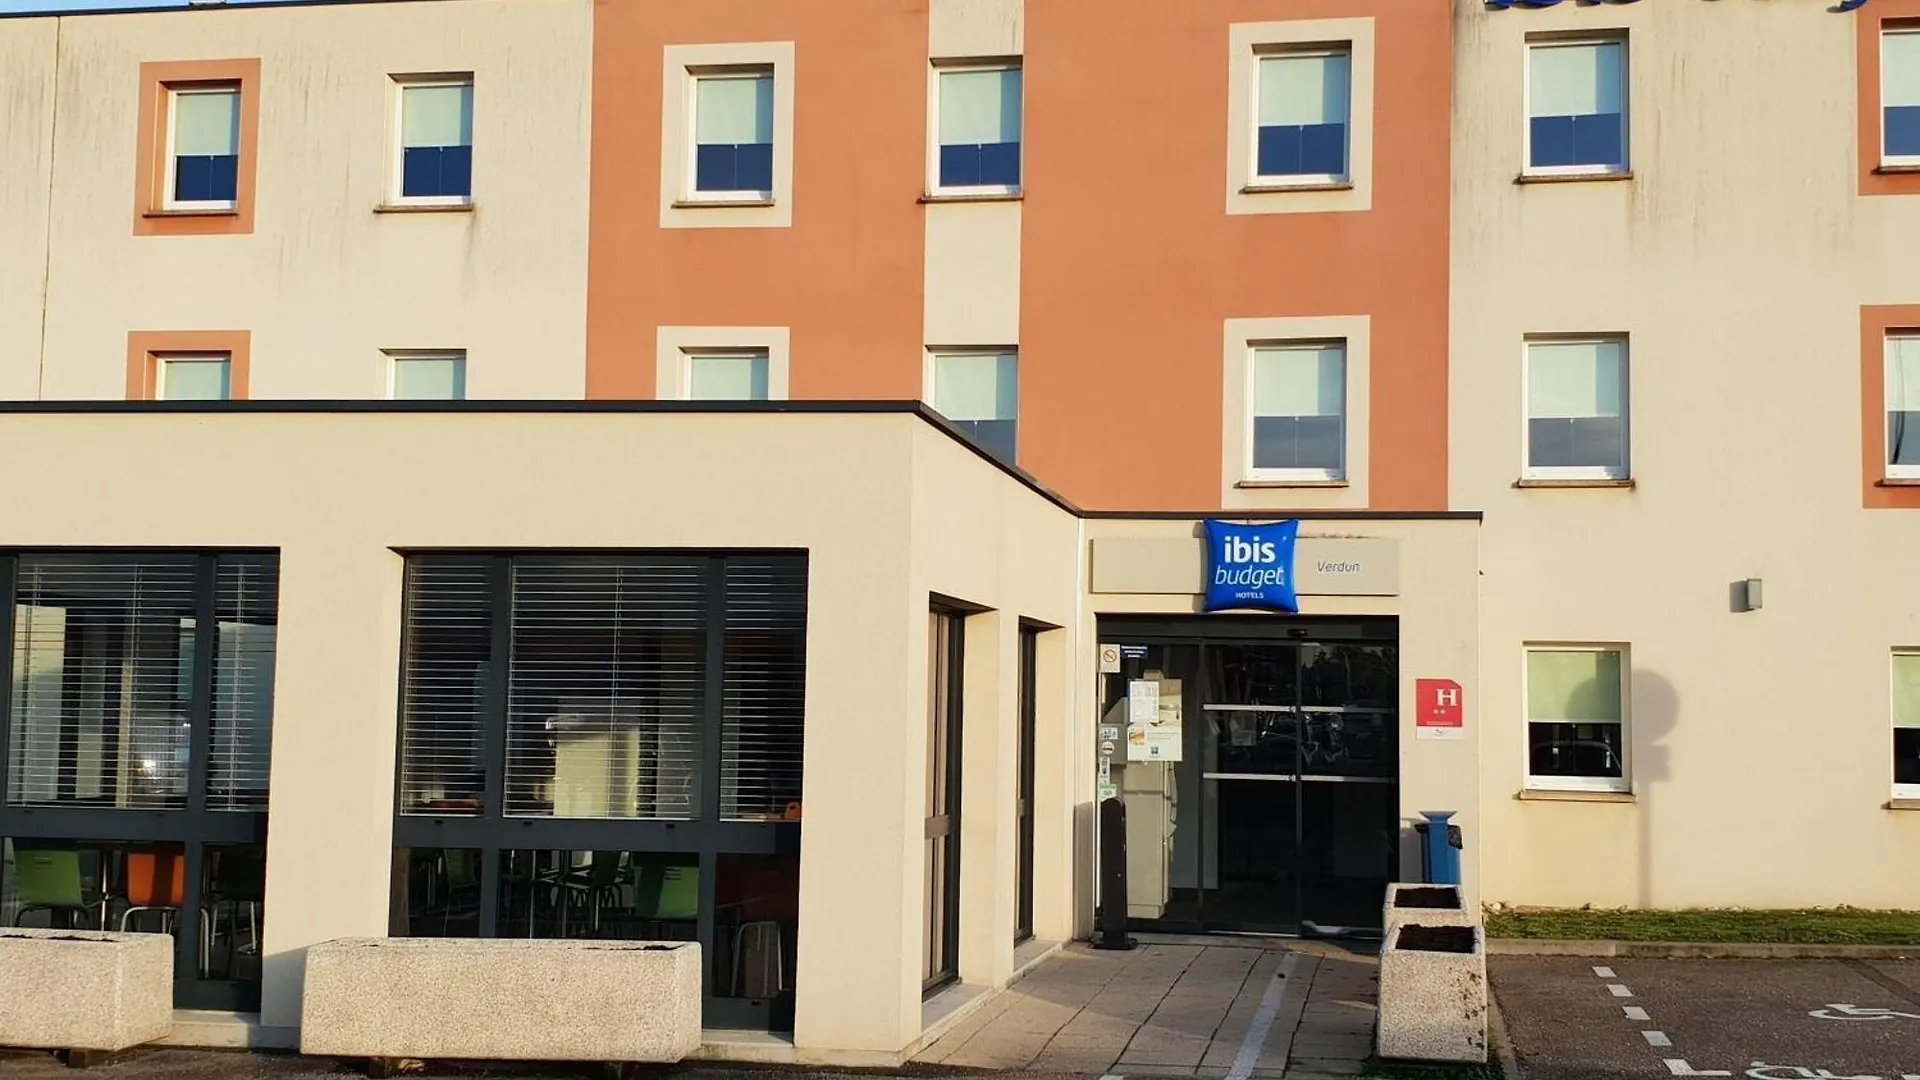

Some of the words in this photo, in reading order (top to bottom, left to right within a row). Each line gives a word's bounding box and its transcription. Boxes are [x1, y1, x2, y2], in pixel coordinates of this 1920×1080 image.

[1224, 535, 1276, 563] ibis
[1215, 565, 1284, 589] budget
[1317, 560, 1360, 573] Verdun
[1436, 688, 1458, 707] H
